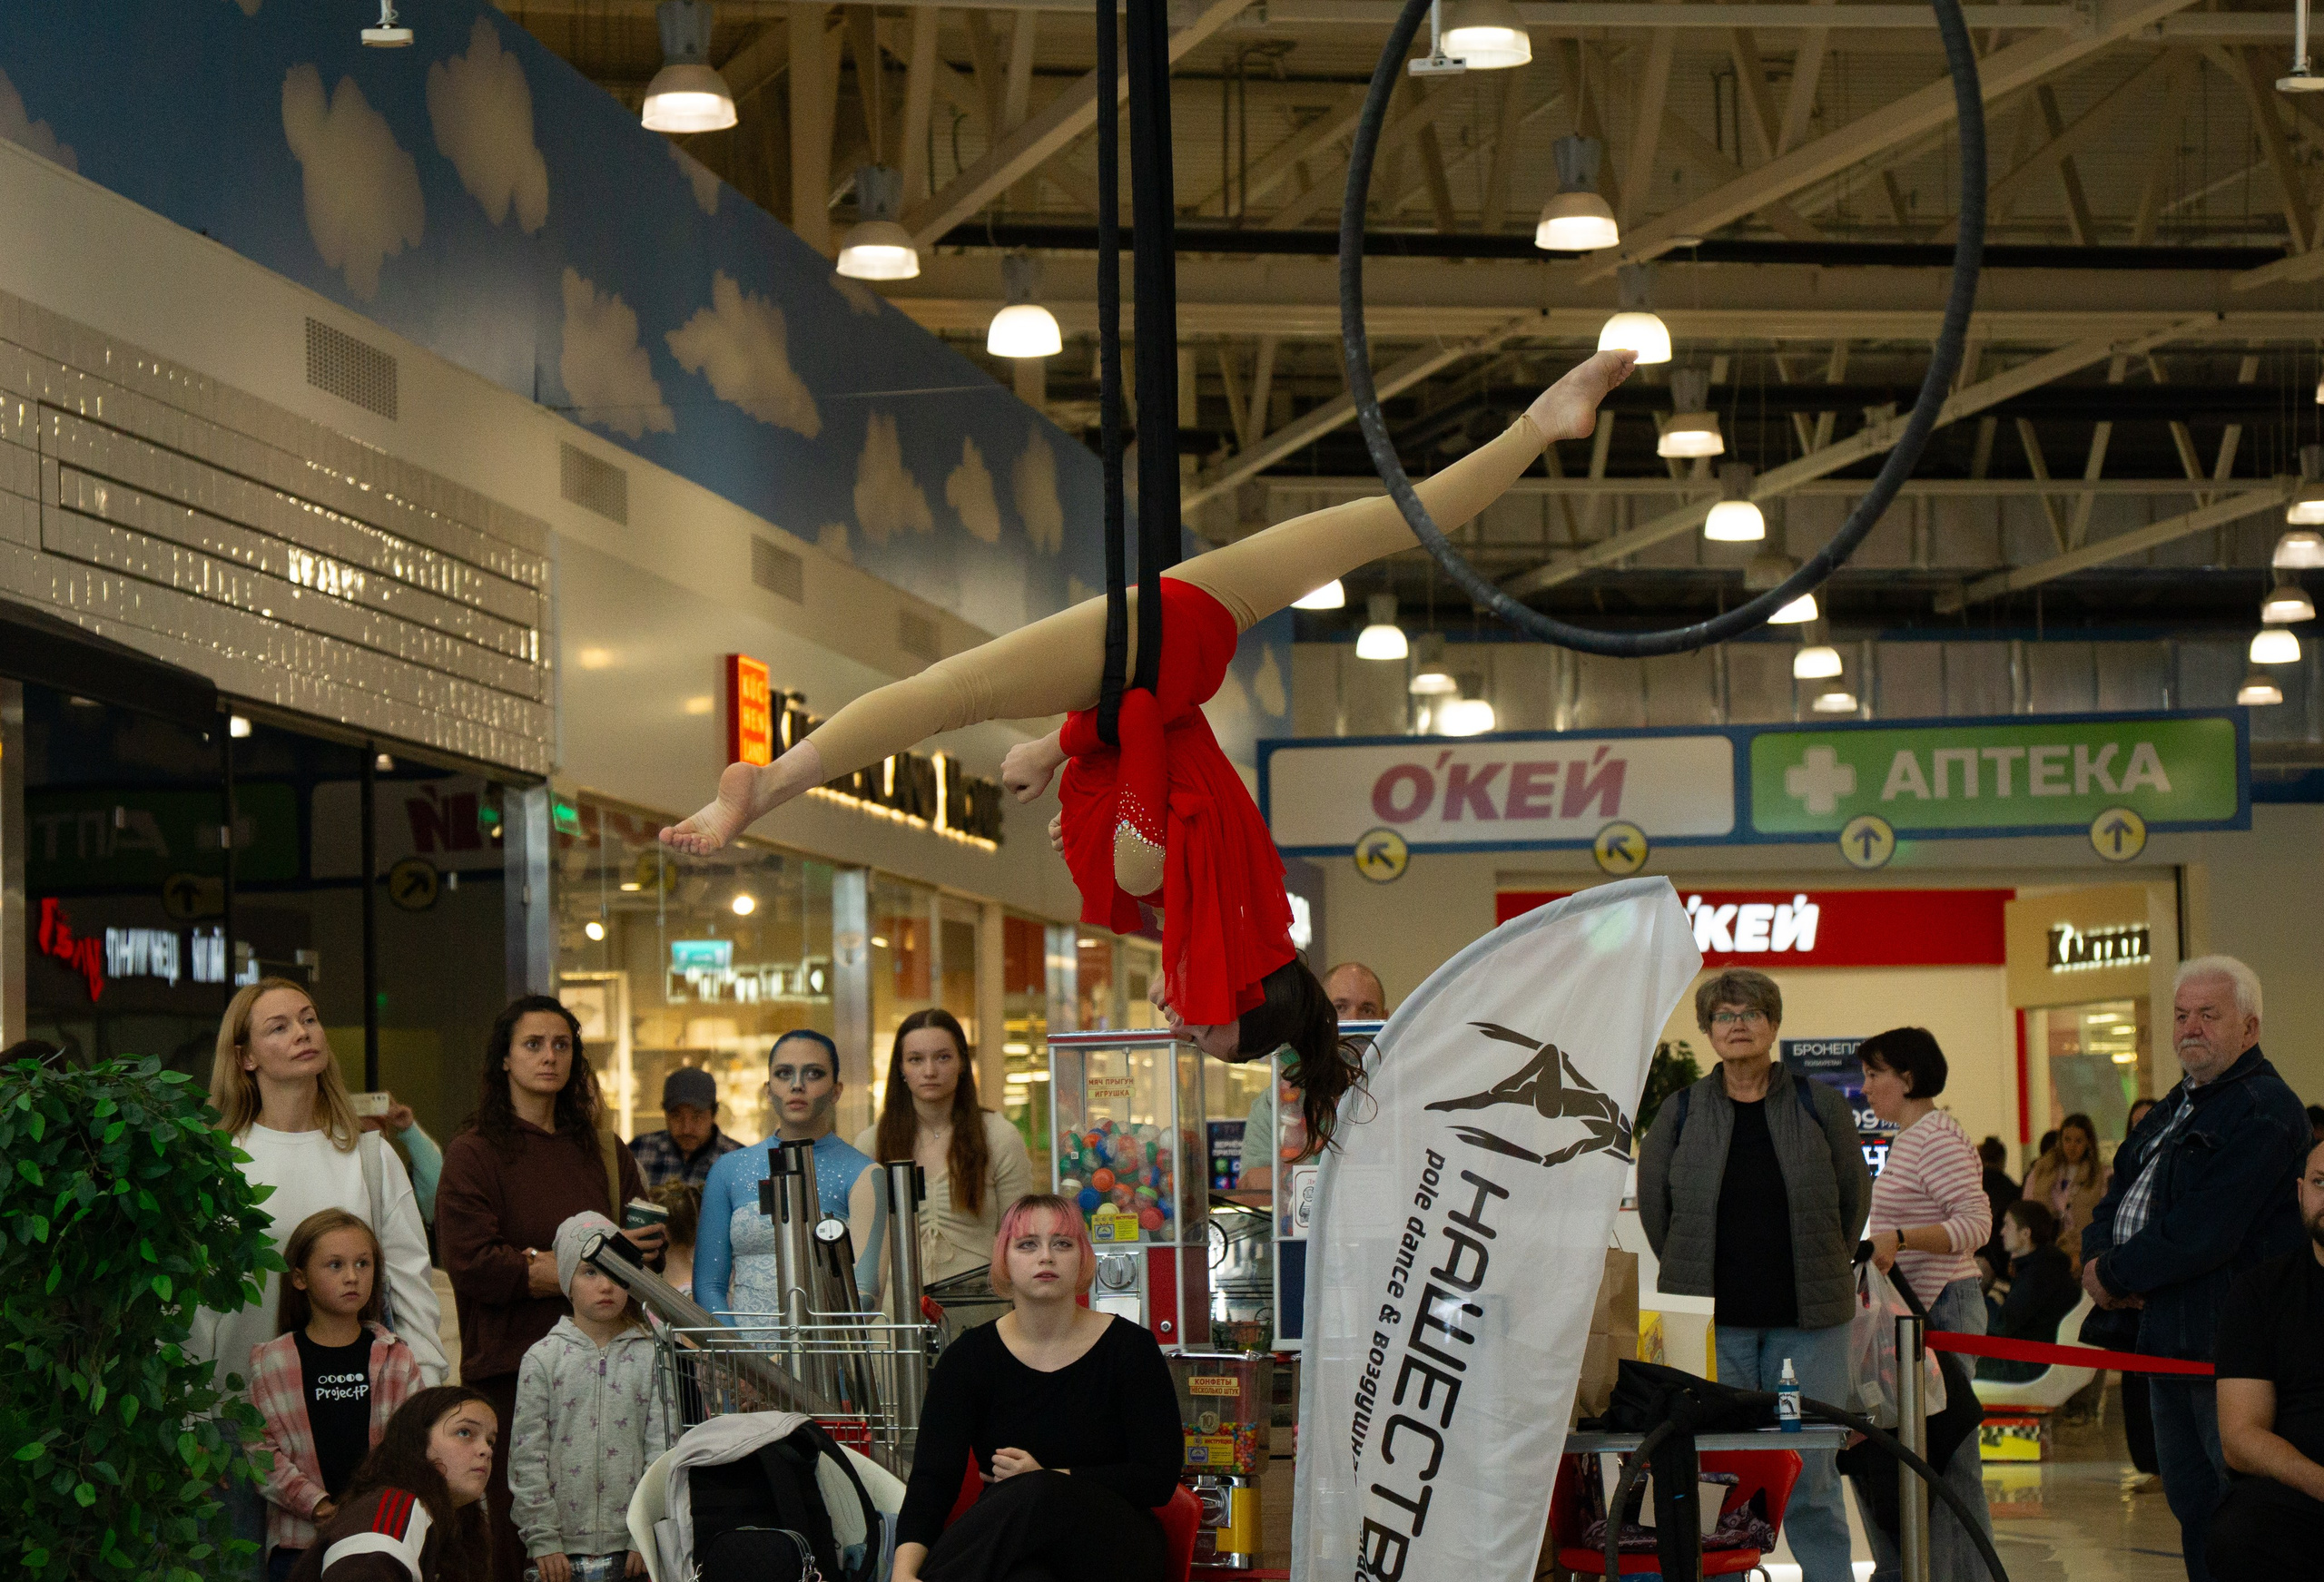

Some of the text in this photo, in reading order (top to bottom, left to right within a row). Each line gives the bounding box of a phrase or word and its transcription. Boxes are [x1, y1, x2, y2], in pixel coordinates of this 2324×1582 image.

[1881, 742, 2171, 801] АПТЕКА
[1684, 894, 1819, 952] 'КЕЙ
[1414, 1148, 1445, 1211] pole
[1387, 1216, 1426, 1299] dance
[1378, 1304, 1401, 1324] &
[1191, 1386, 1223, 1394] НЕСКОЛЬКО
